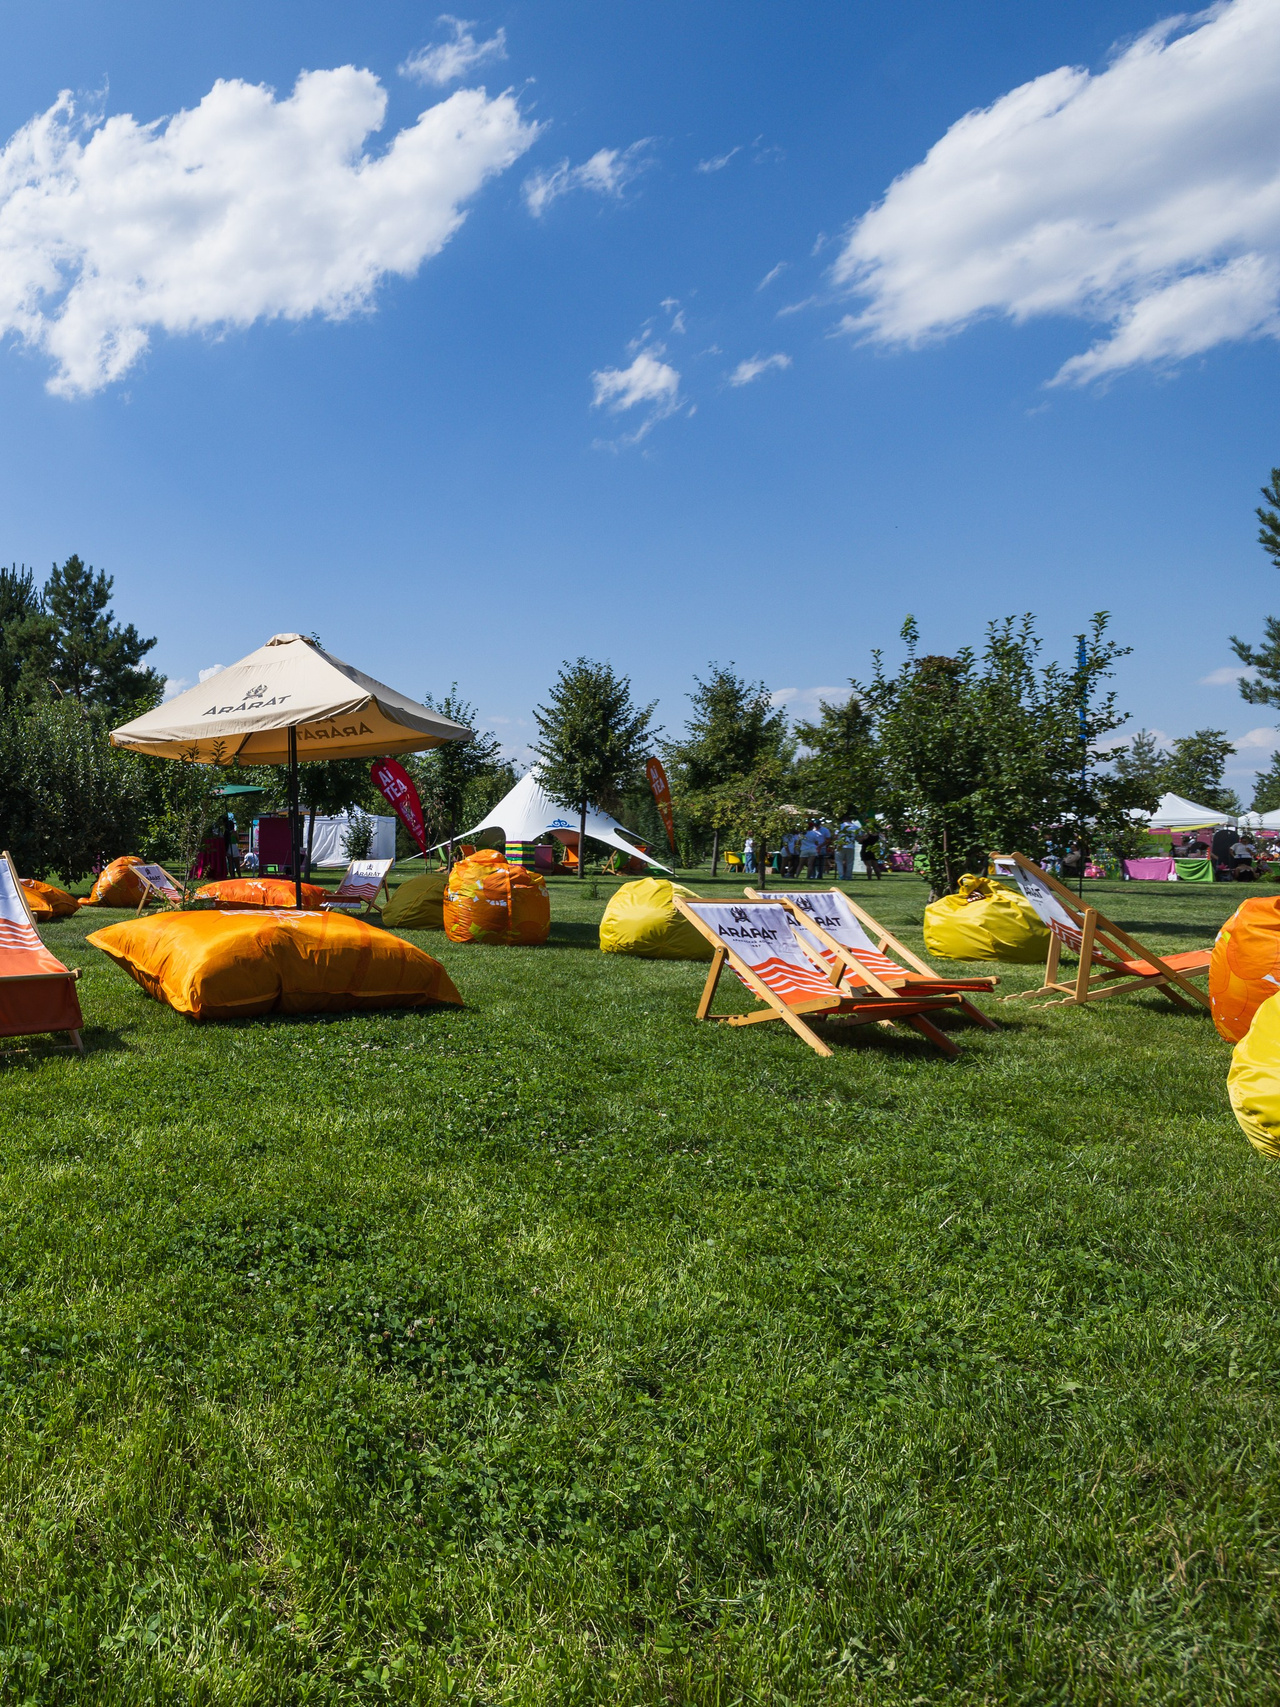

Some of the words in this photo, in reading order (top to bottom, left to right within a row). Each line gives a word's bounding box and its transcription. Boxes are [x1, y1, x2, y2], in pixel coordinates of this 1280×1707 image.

[202, 694, 291, 716] ARARAT
[383, 778, 408, 802] TEA
[786, 915, 842, 927] ARAT
[718, 923, 778, 941] ARARAT
